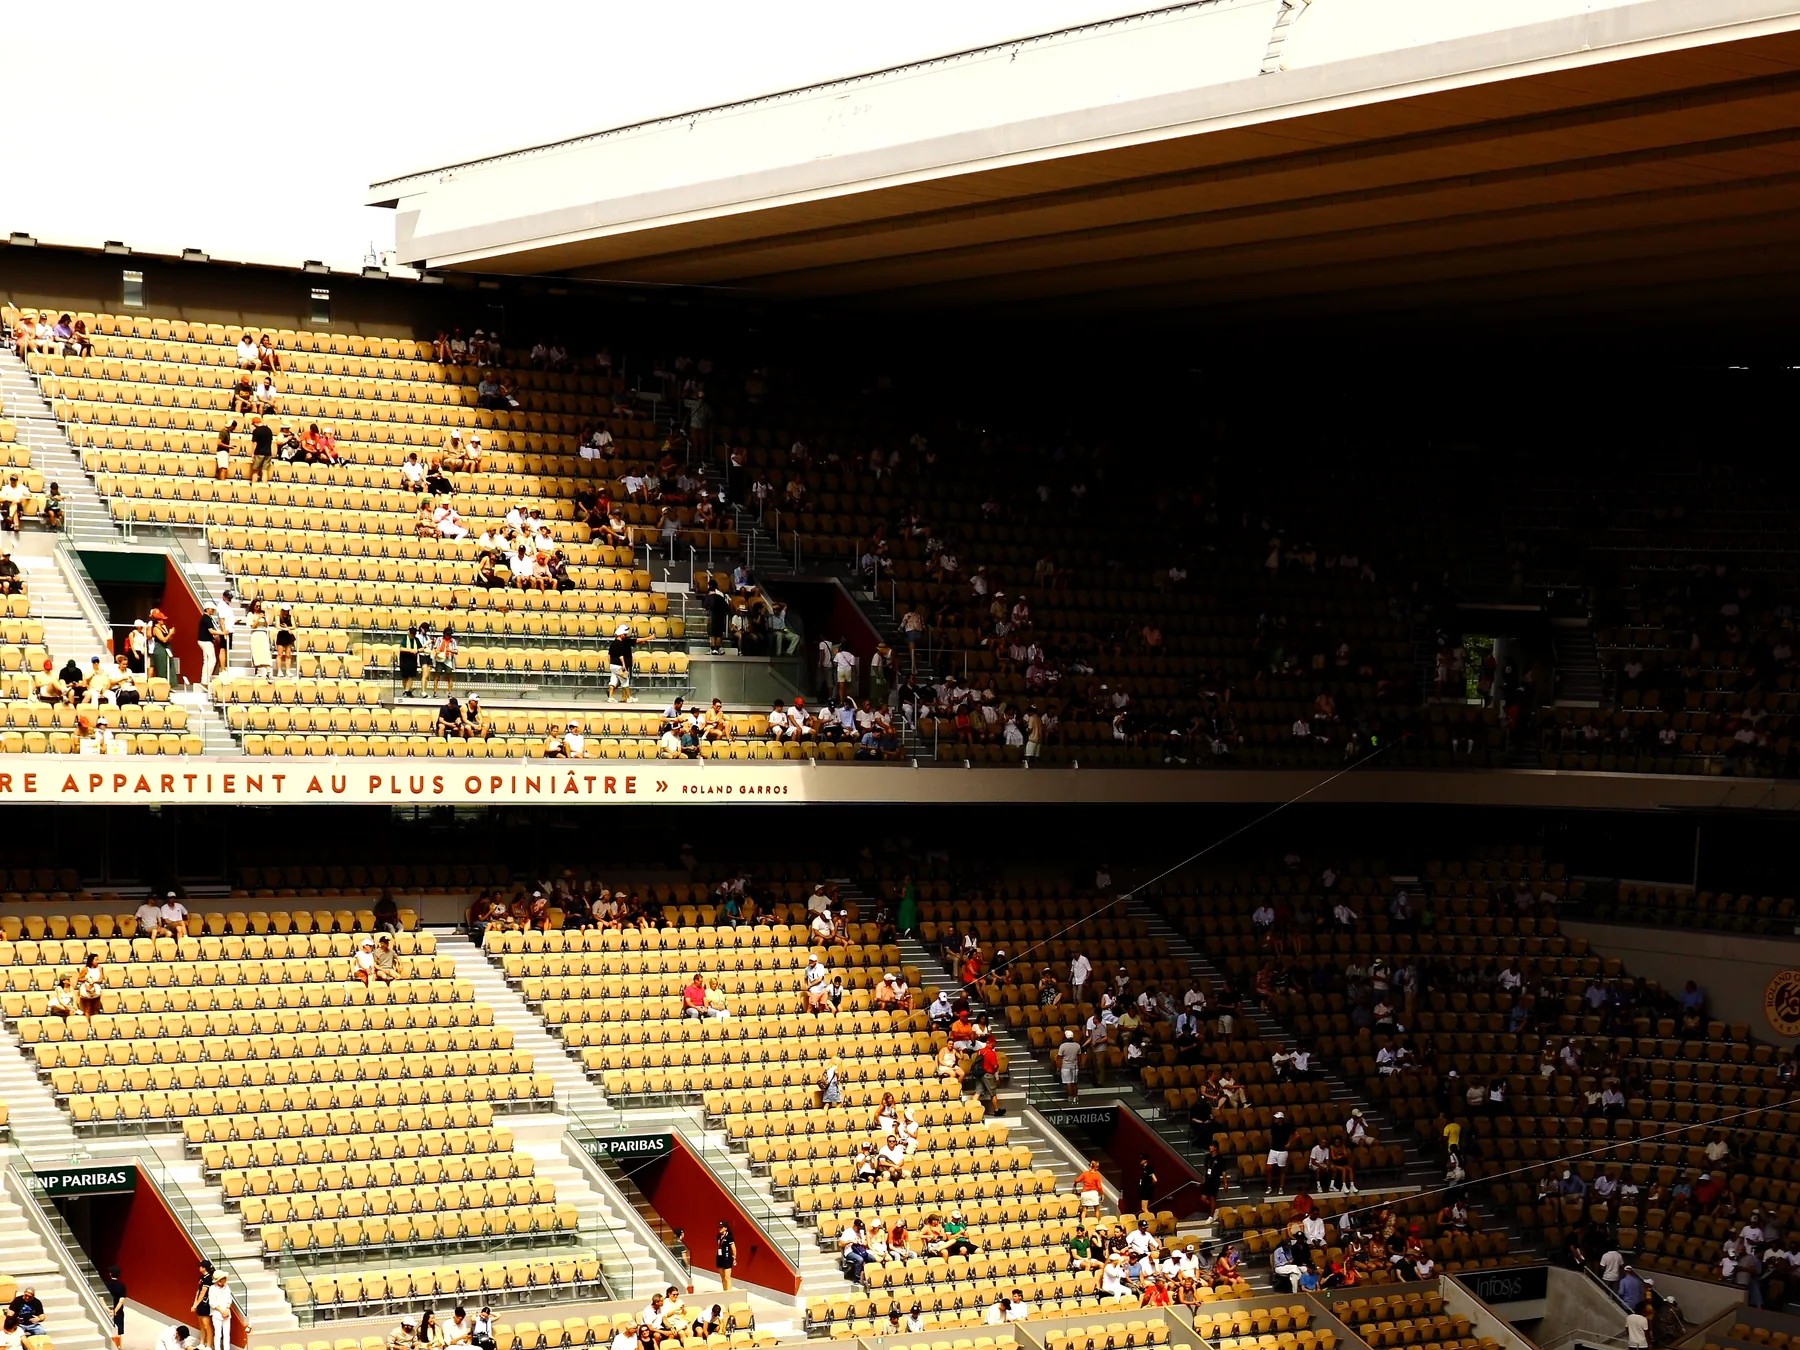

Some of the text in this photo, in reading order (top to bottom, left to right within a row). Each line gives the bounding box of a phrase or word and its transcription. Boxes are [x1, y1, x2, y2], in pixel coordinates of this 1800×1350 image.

[61, 773, 286, 793] APPARTIENT
[306, 774, 347, 794] AU
[369, 775, 444, 794] PLUS
[464, 770, 637, 794] OPINIÂTRE
[682, 785, 788, 794] ROLAND GARROS
[1045, 1112, 1111, 1125] NP PARIBAS
[611, 1139, 664, 1153] PARIBAS
[26, 1171, 127, 1189] BNP PARIBAS
[1476, 1276, 1523, 1298] Infosys
